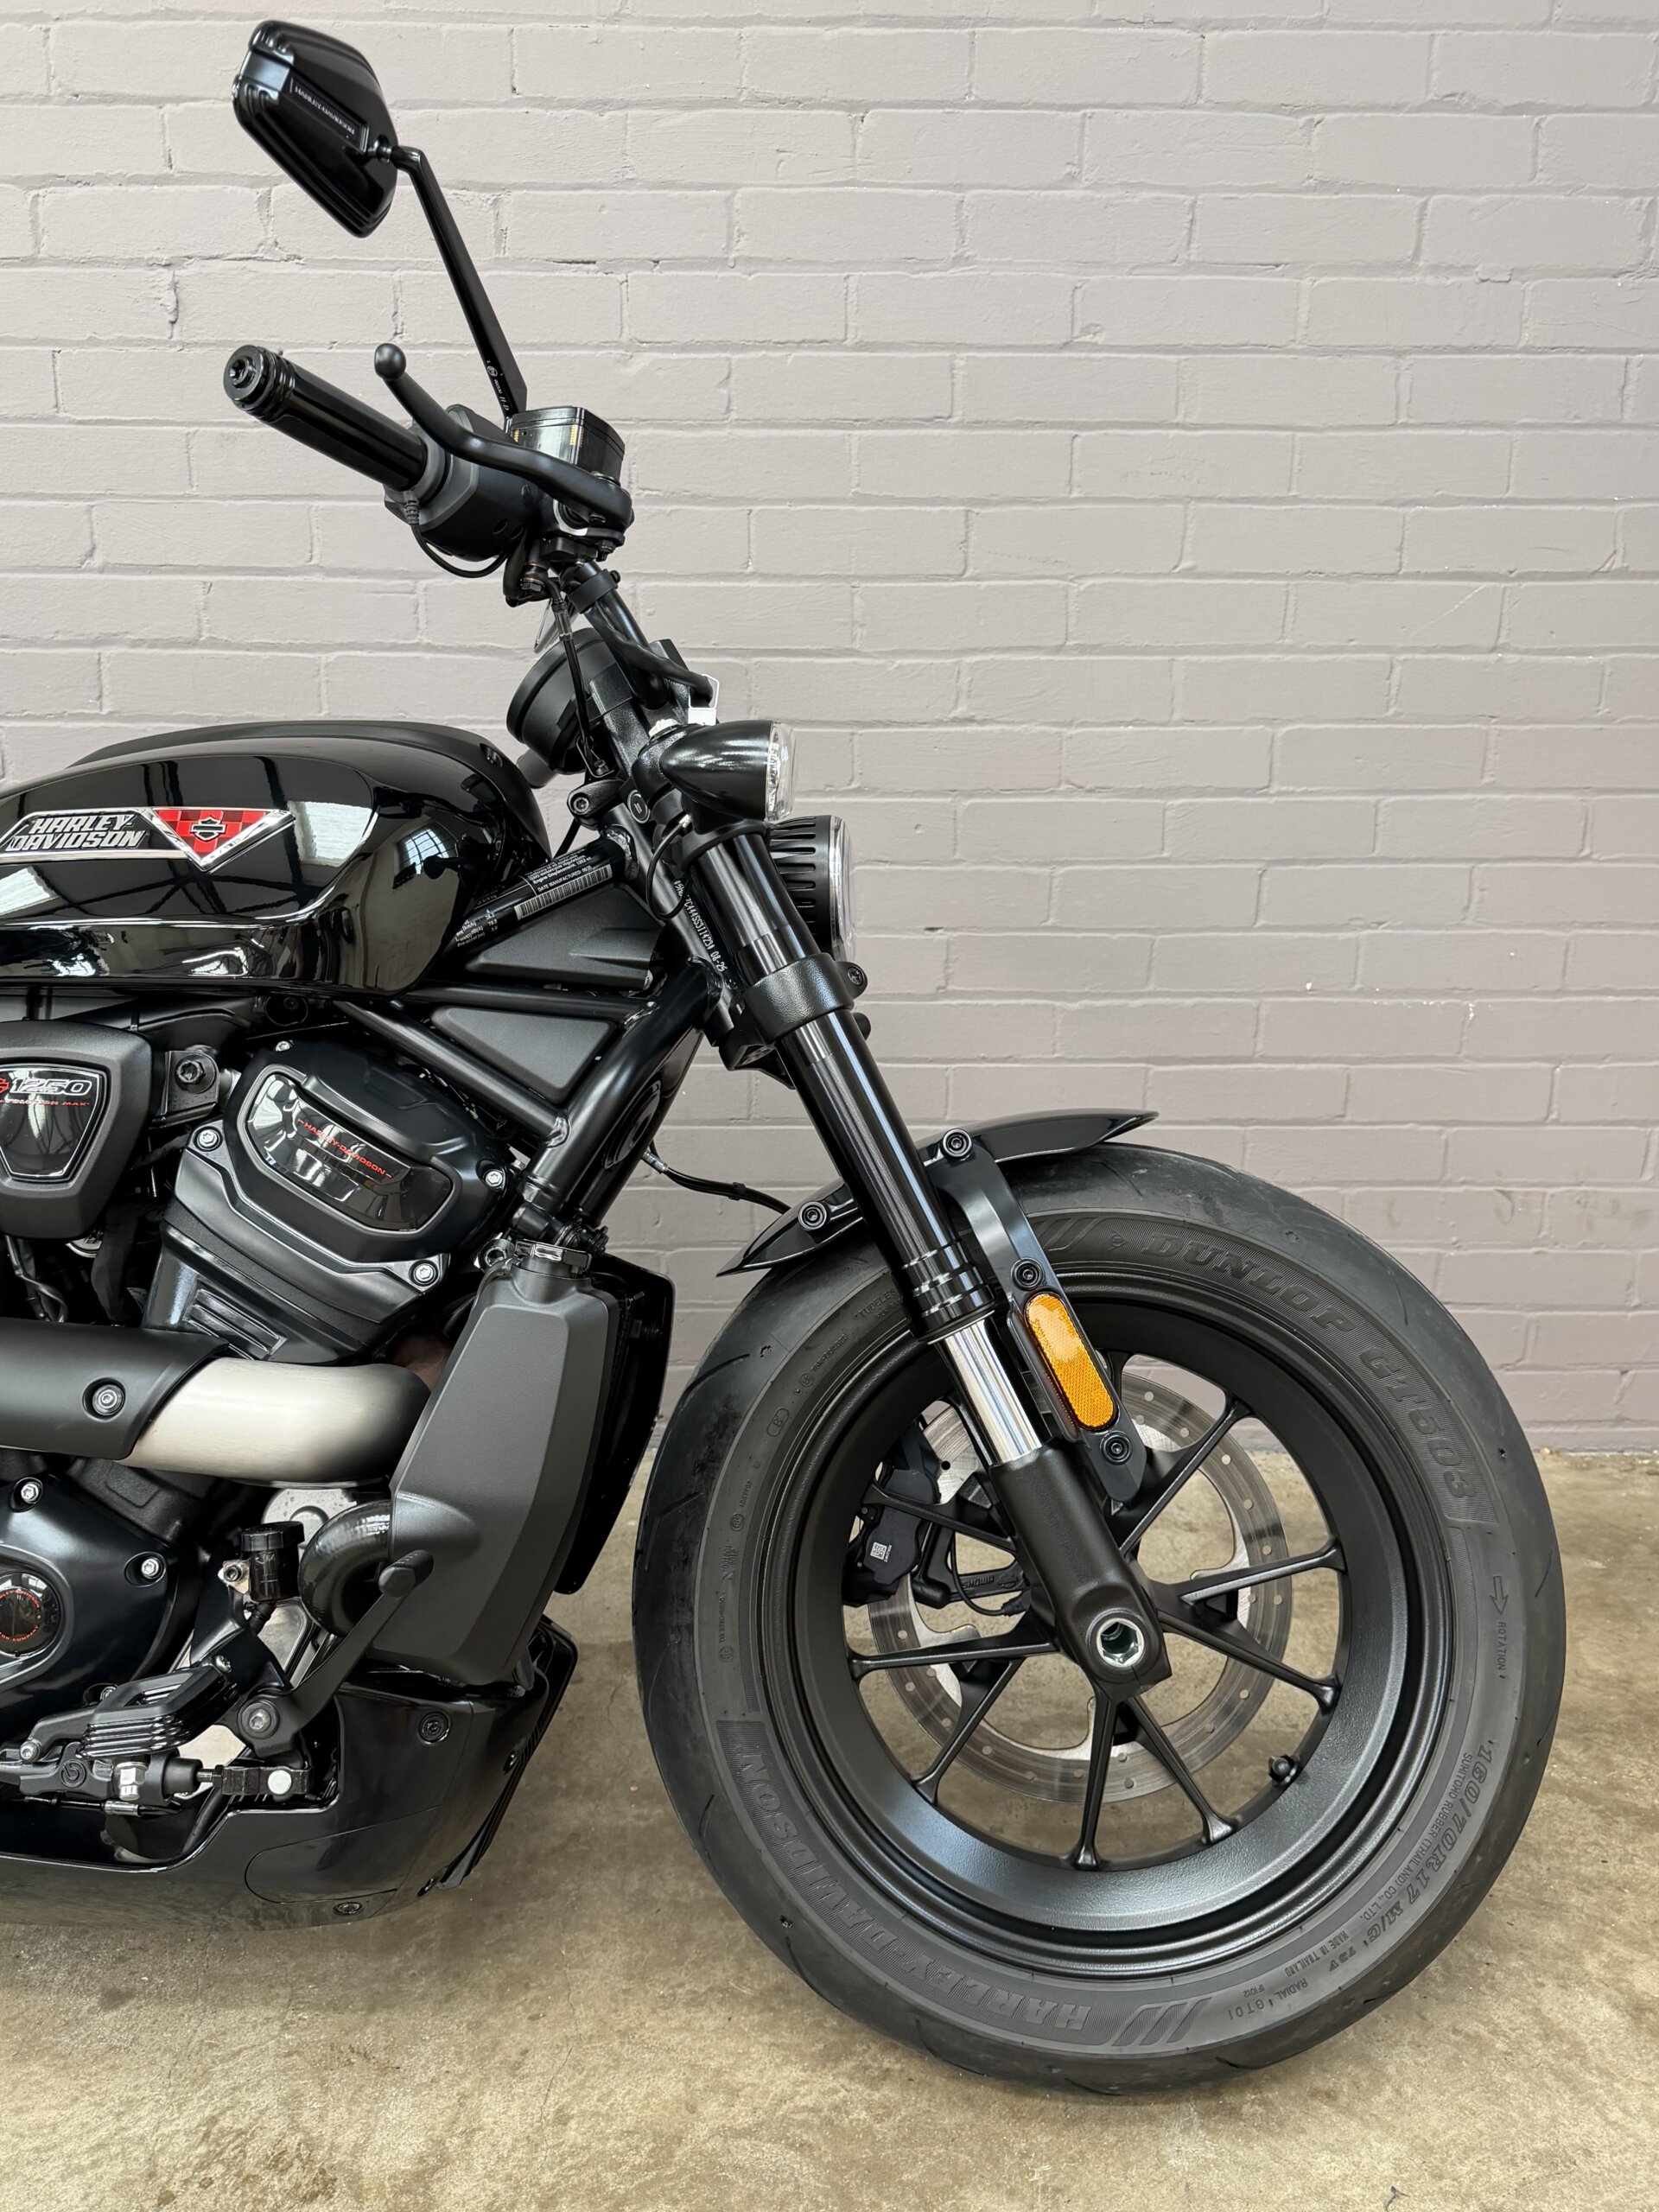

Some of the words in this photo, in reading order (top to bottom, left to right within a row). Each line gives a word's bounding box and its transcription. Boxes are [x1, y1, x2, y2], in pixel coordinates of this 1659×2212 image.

[4, 830, 147, 852] DAVIDSON
[10, 1077, 92, 1096] 1250
[1142, 1231, 1356, 1332] DUNLOP
[859, 1287, 897, 1318] TUBELES
[1497, 1621, 1507, 1670] ROTATION
[1448, 1752, 1473, 1799] SUMITOMO
[1428, 1800, 1453, 1839] RUBBER
[1396, 1838, 1433, 1886] (THAILAND)
[1319, 1944, 1331, 1955] IN
[1328, 1930, 1350, 1950] MADE
[1284, 1950, 1321, 1978] THAILAND
[1274, 1978, 1308, 2000] RADIAL
